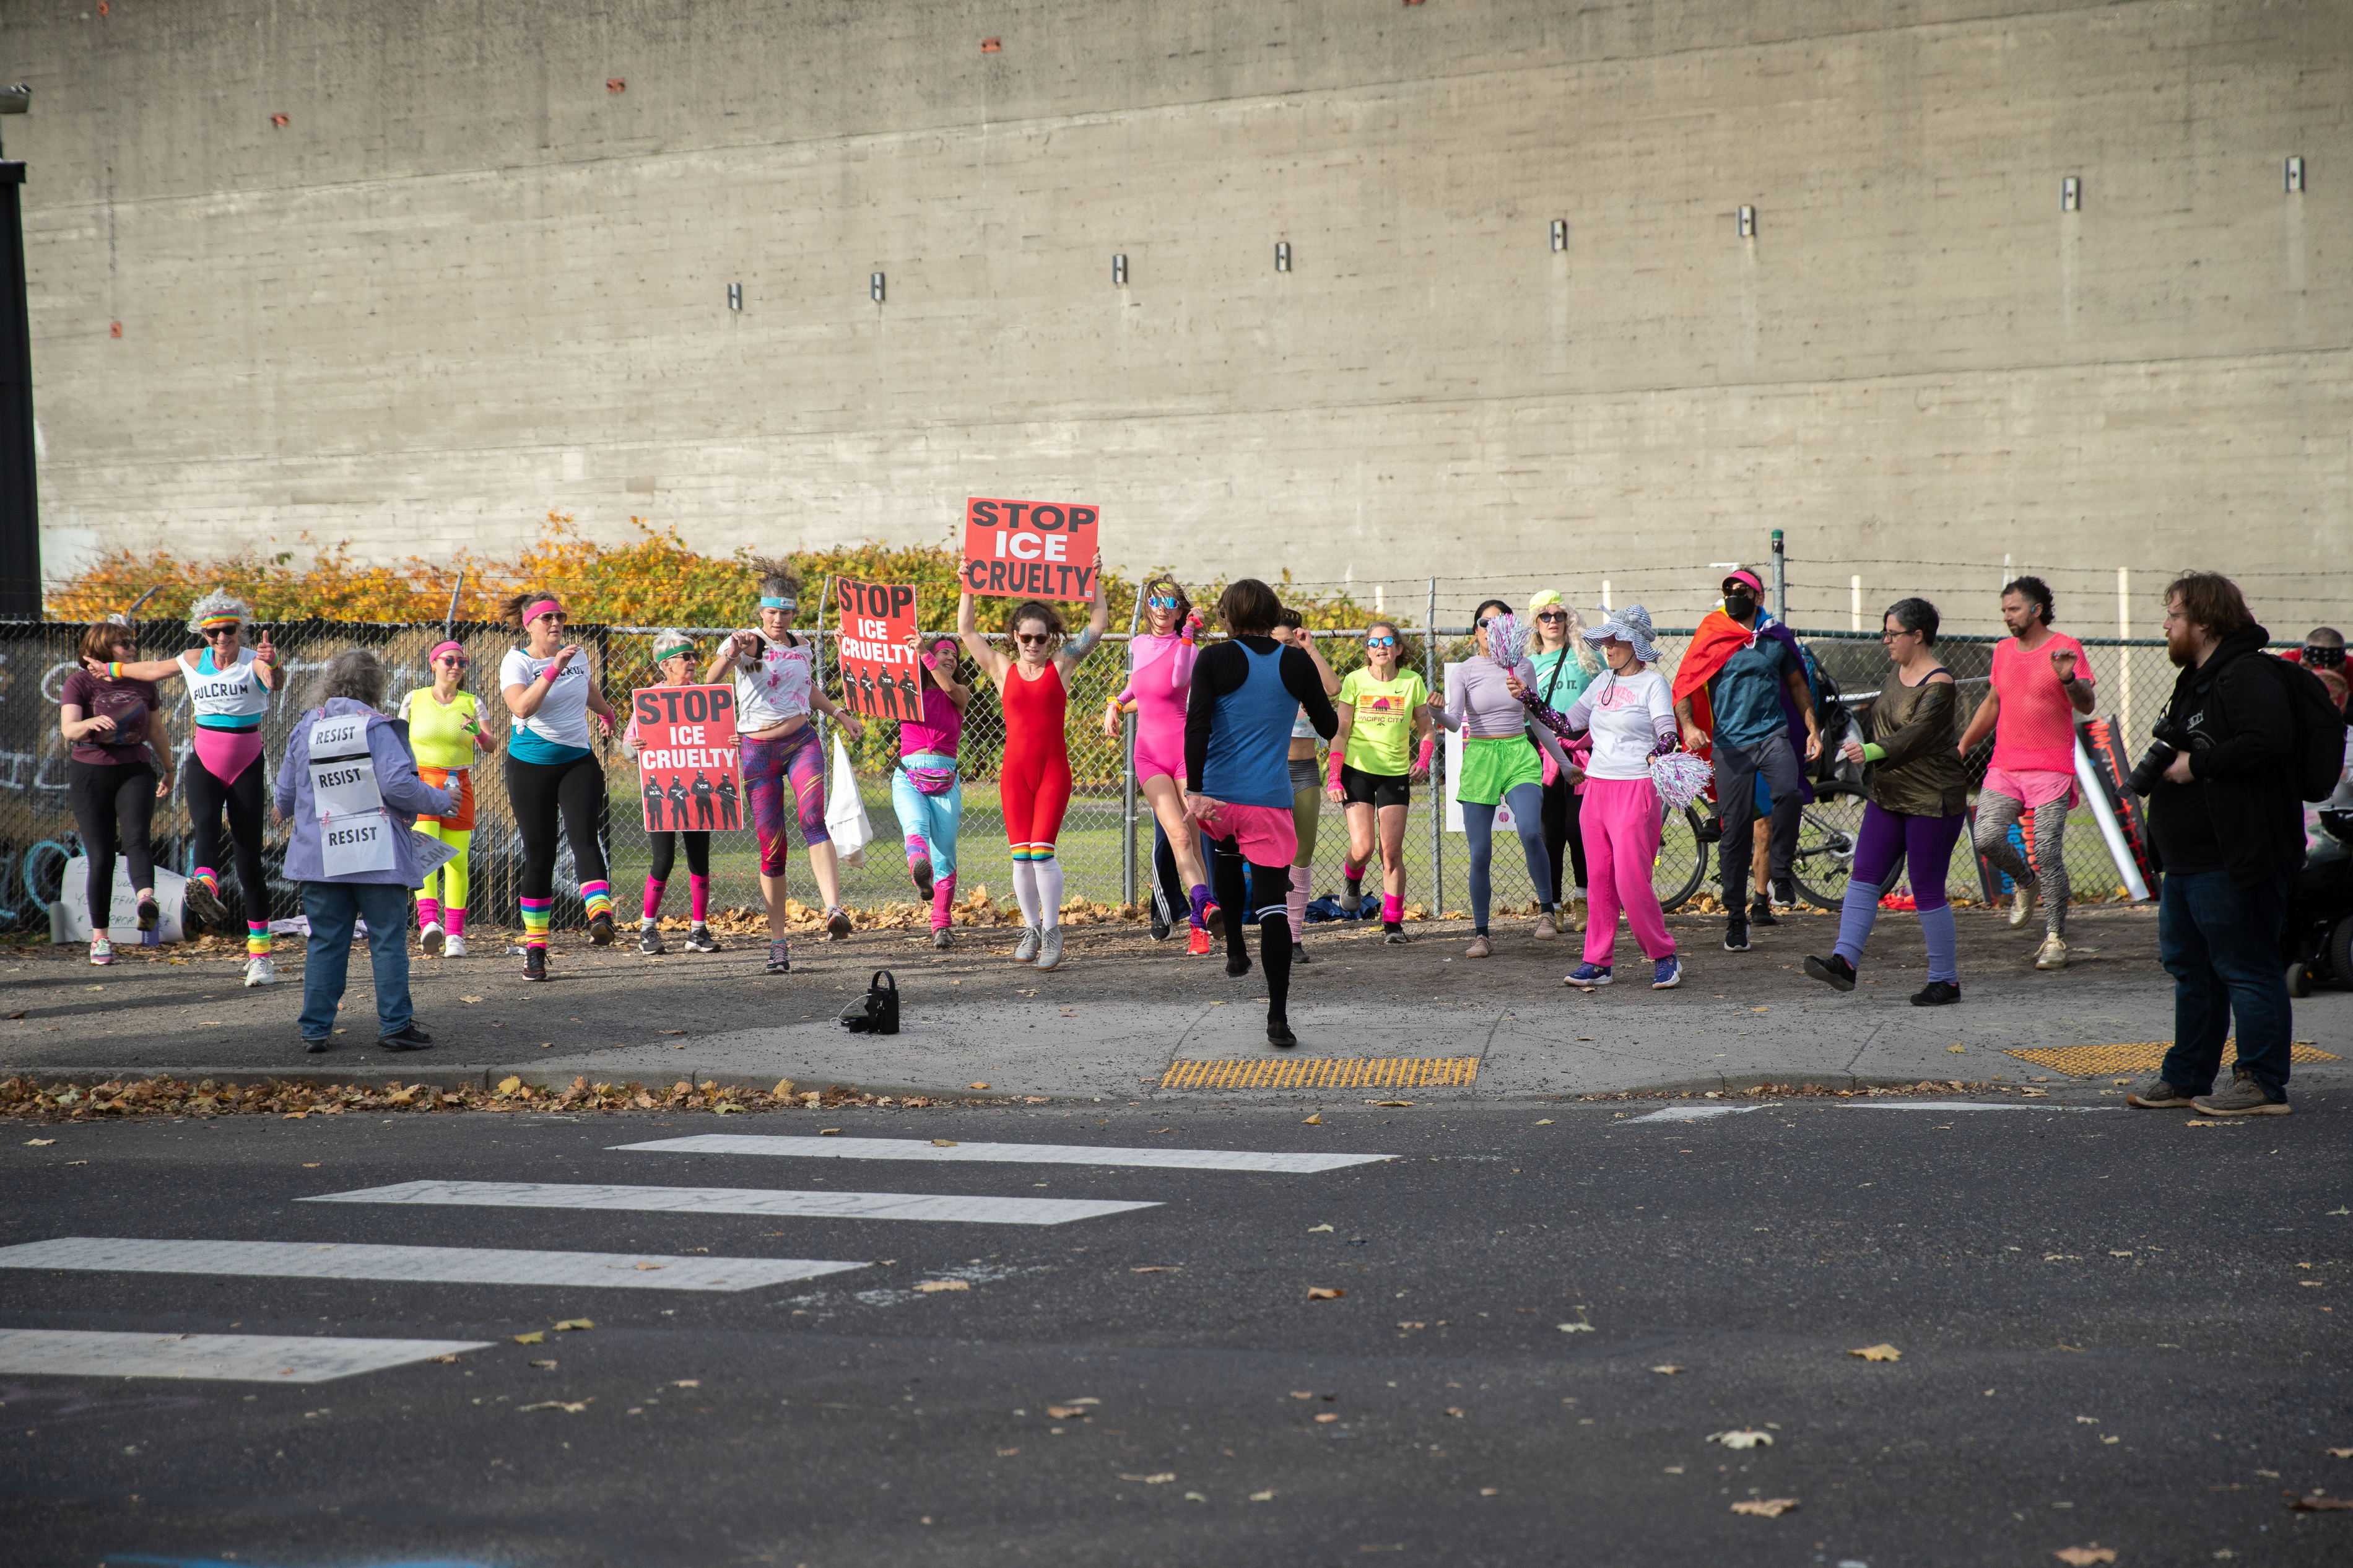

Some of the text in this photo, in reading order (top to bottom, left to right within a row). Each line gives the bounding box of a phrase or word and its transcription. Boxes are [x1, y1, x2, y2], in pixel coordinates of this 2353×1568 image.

[972, 501, 1096, 533] STOP
[995, 530, 1068, 562] ICE
[968, 559, 1093, 596] CRUELTY
[839, 578, 913, 618] STOP
[858, 618, 888, 640] ICE
[842, 637, 915, 664] CRUELTY
[194, 683, 248, 700] FULCRUM
[1567, 680, 1577, 689] IT.
[637, 689, 732, 725] STOP
[316, 726, 355, 744] RESIST
[669, 725, 705, 746] ICE
[642, 748, 735, 770] CRUELTY
[318, 768, 361, 788] RESIST
[329, 827, 376, 846] RESIST
